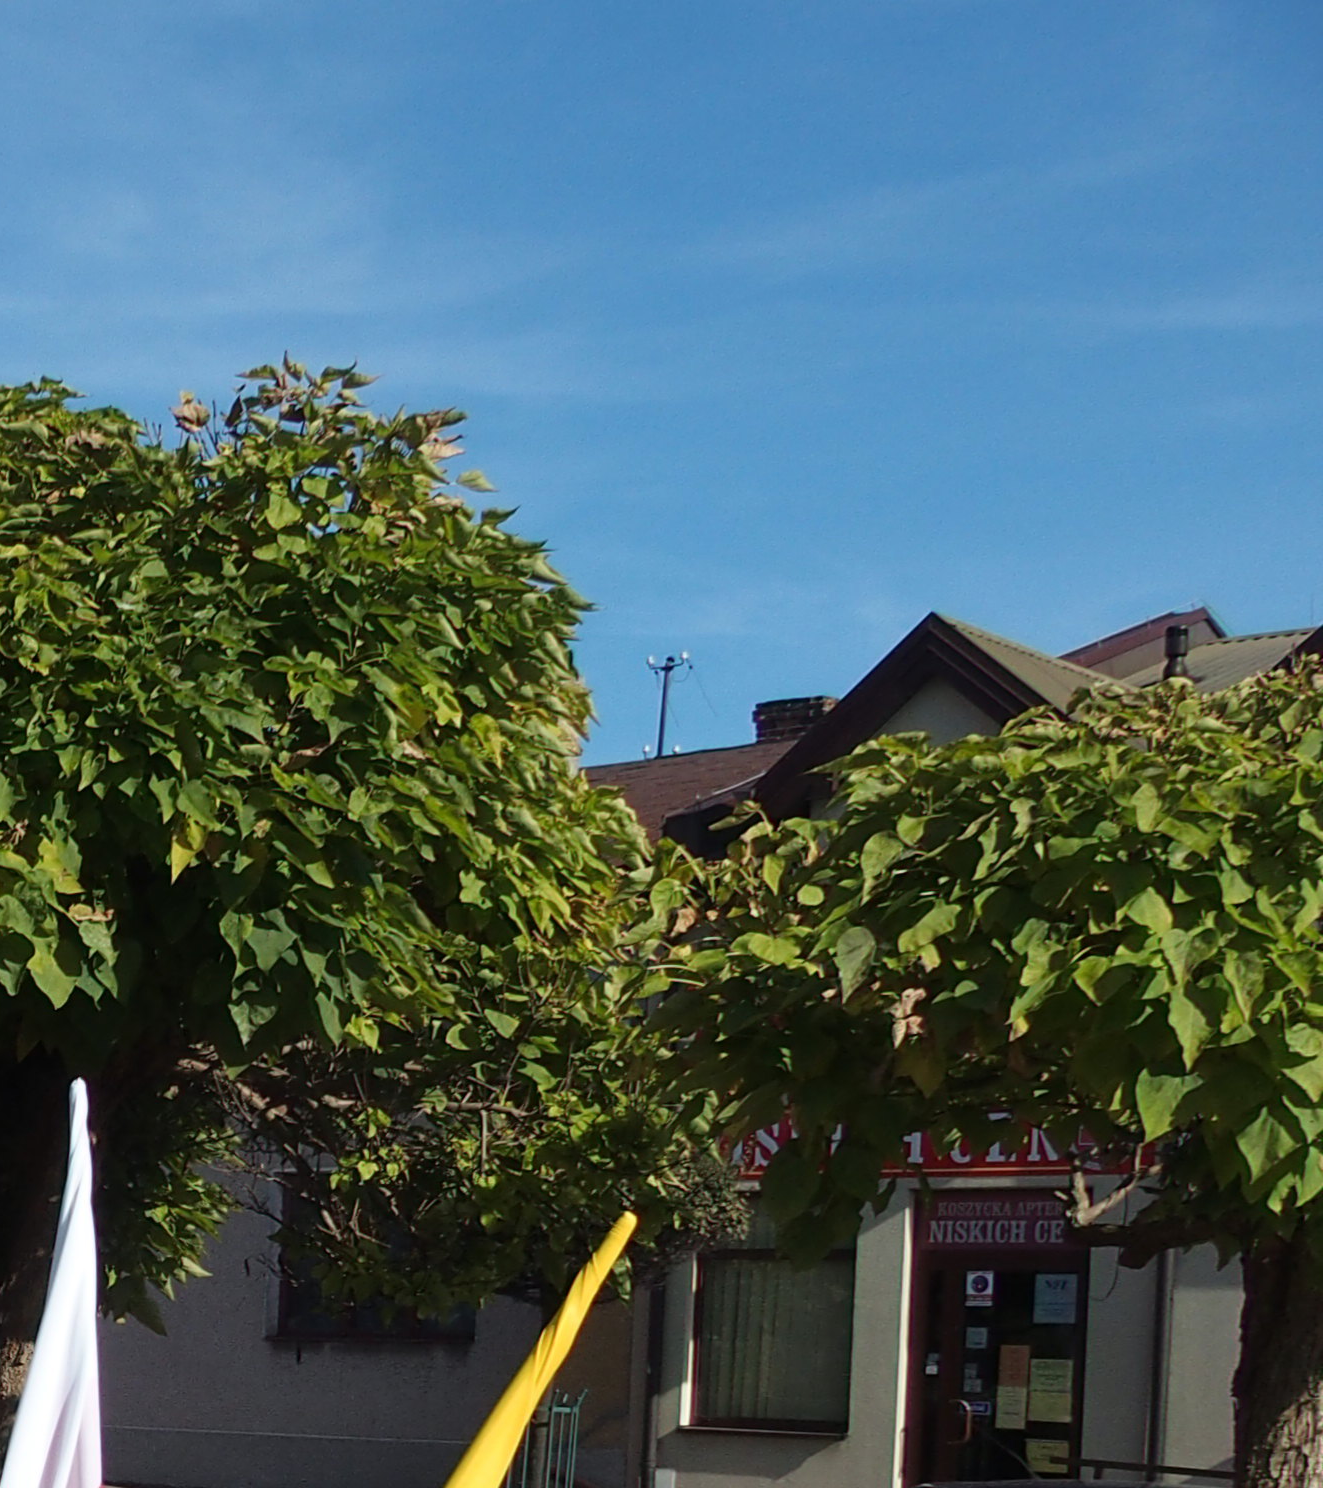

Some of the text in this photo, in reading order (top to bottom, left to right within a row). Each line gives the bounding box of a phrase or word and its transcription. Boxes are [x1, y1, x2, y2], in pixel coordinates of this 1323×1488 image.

[938, 1201, 1012, 1217] KOSZYCKA
[928, 1219, 1065, 1244] NISKICH CE
